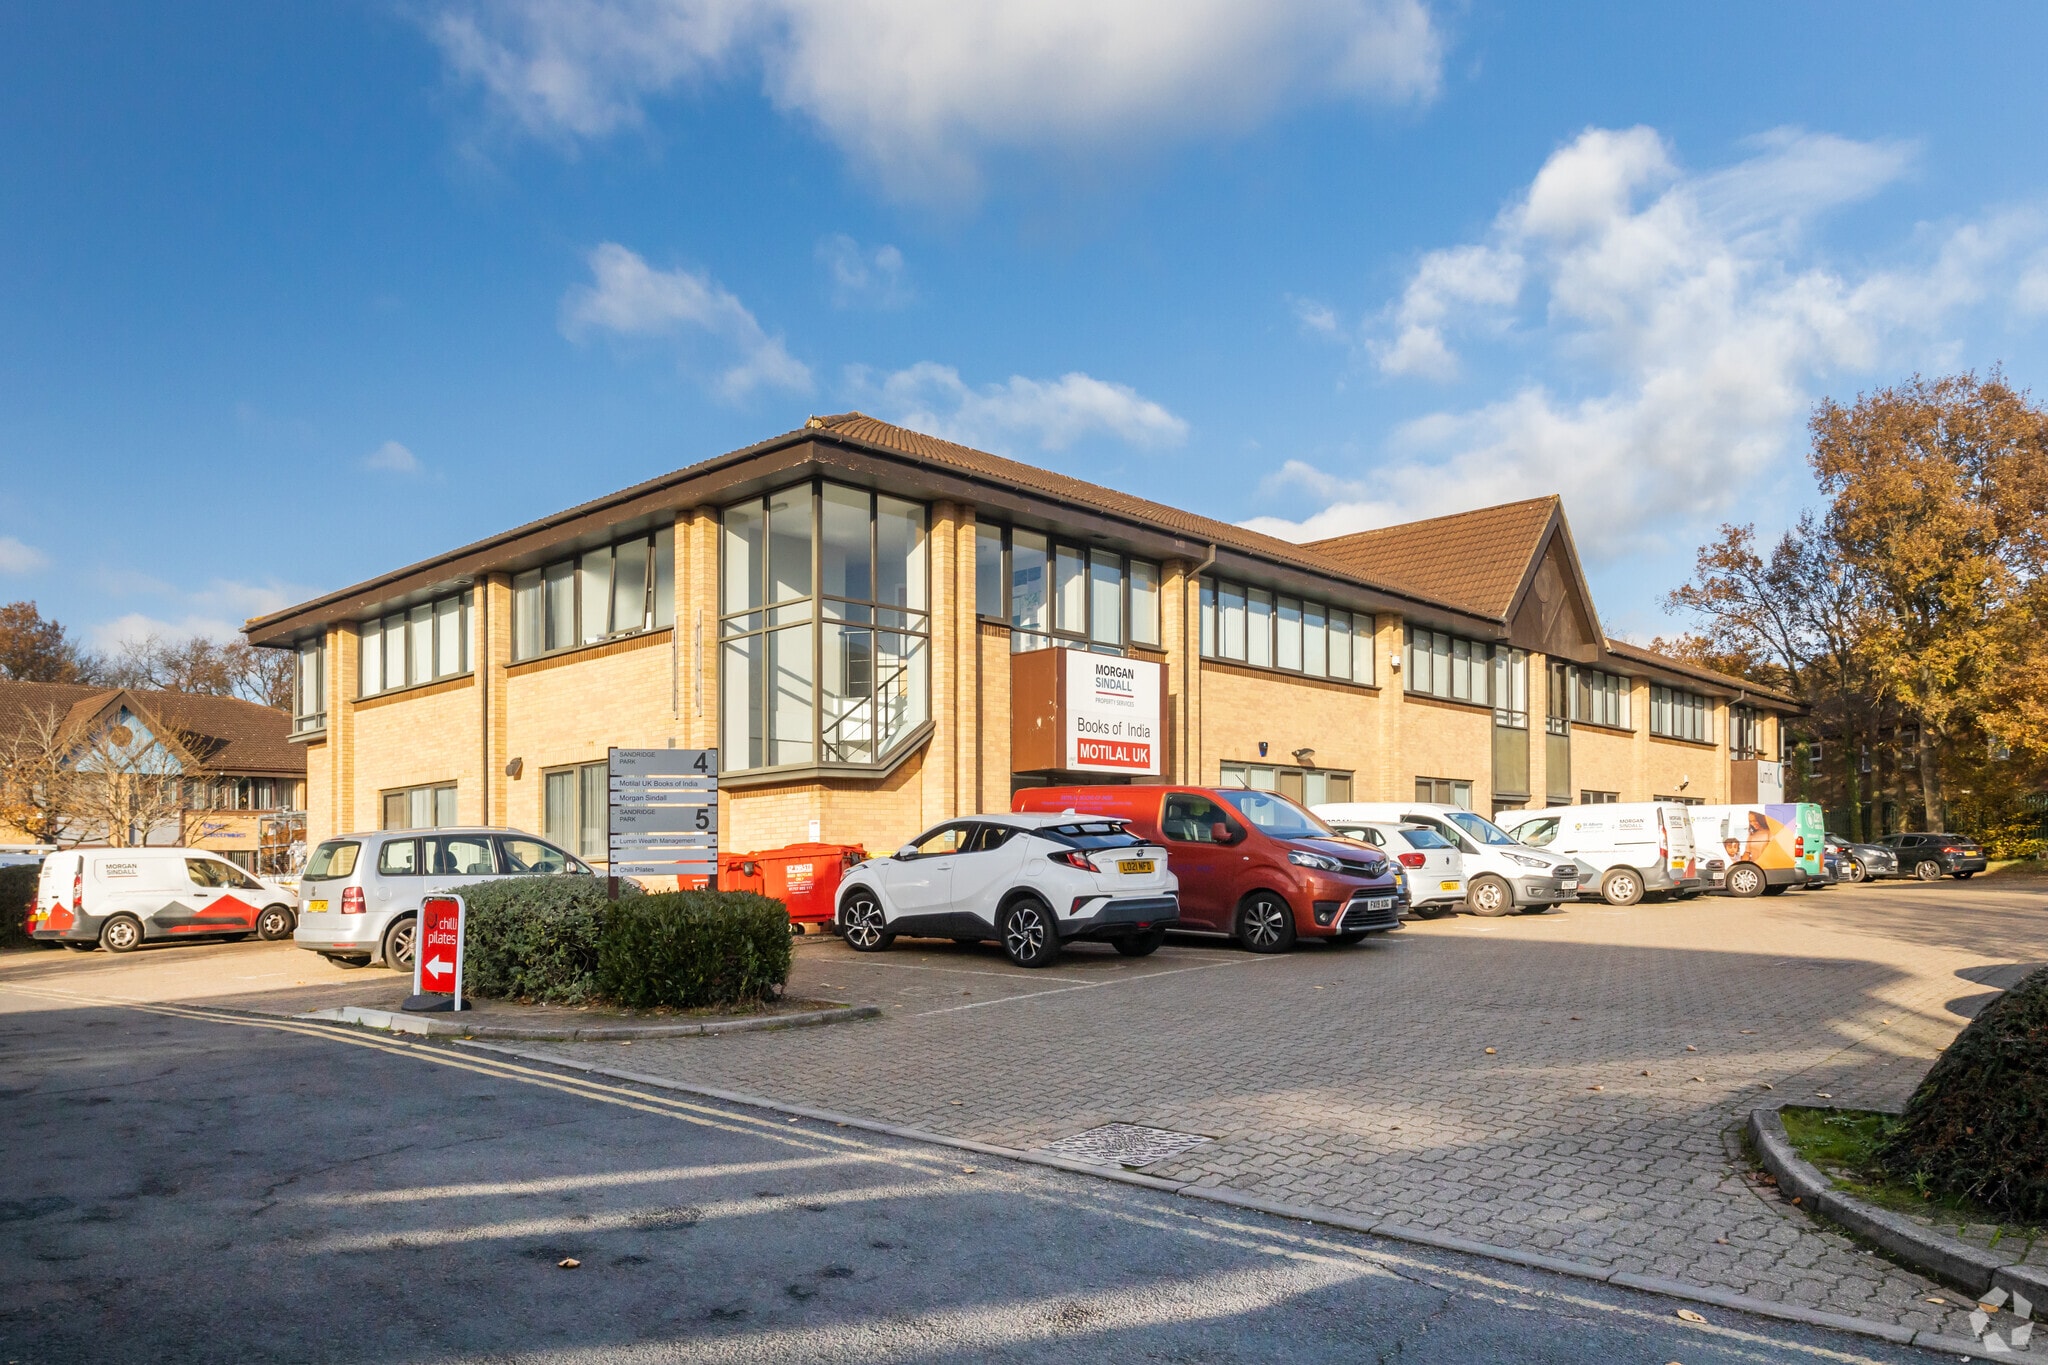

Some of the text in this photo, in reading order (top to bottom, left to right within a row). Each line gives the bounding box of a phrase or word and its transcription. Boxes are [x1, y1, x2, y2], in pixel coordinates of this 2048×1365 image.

[1095, 664, 1134, 680] MORGAN
[1095, 677, 1132, 692] SINDALL
[1095, 697, 1135, 708] PROPERTY SERVICES
[1077, 717, 1150, 738] Books of India
[1080, 743, 1130, 762] MOTILAL
[1132, 748, 1148, 763] UK
[693, 752, 709, 773] 4
[695, 808, 710, 830] 5
[439, 917, 458, 930] chilli
[428, 931, 457, 947] pilates
